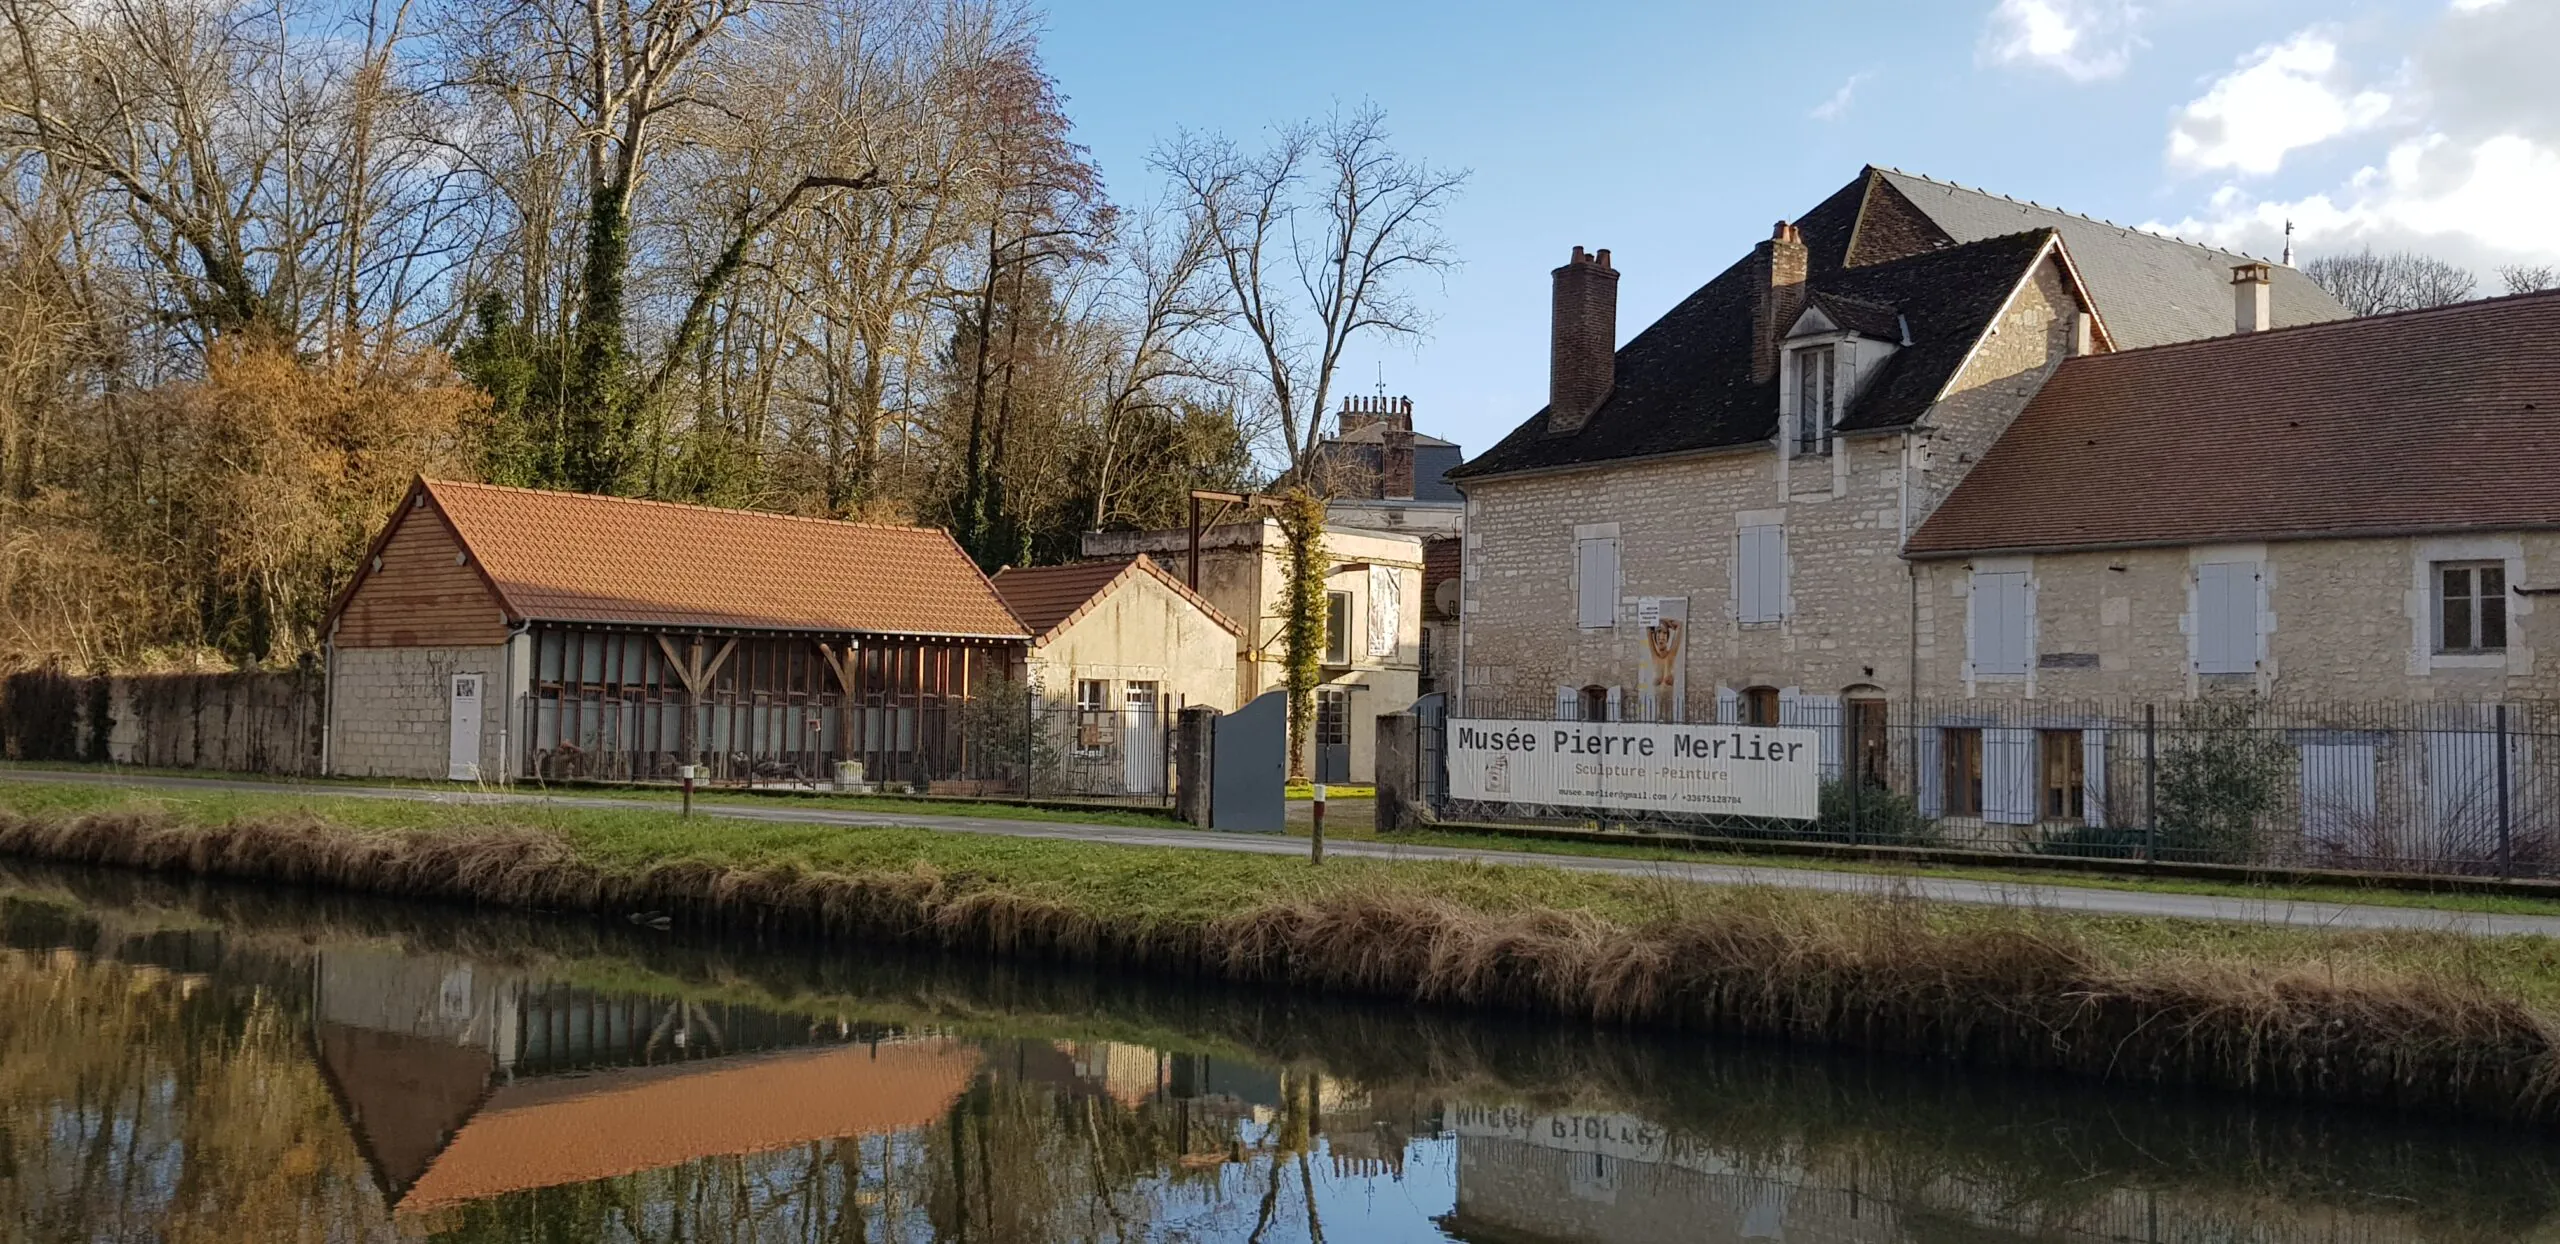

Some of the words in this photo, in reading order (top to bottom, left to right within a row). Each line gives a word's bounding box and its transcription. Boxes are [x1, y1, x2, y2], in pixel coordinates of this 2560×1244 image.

[1459, 727, 1536, 751] Musée
[1554, 730, 1655, 757] Pierre
[1674, 733, 1803, 762] Merlier
[1575, 763, 1646, 778] Sculpture
